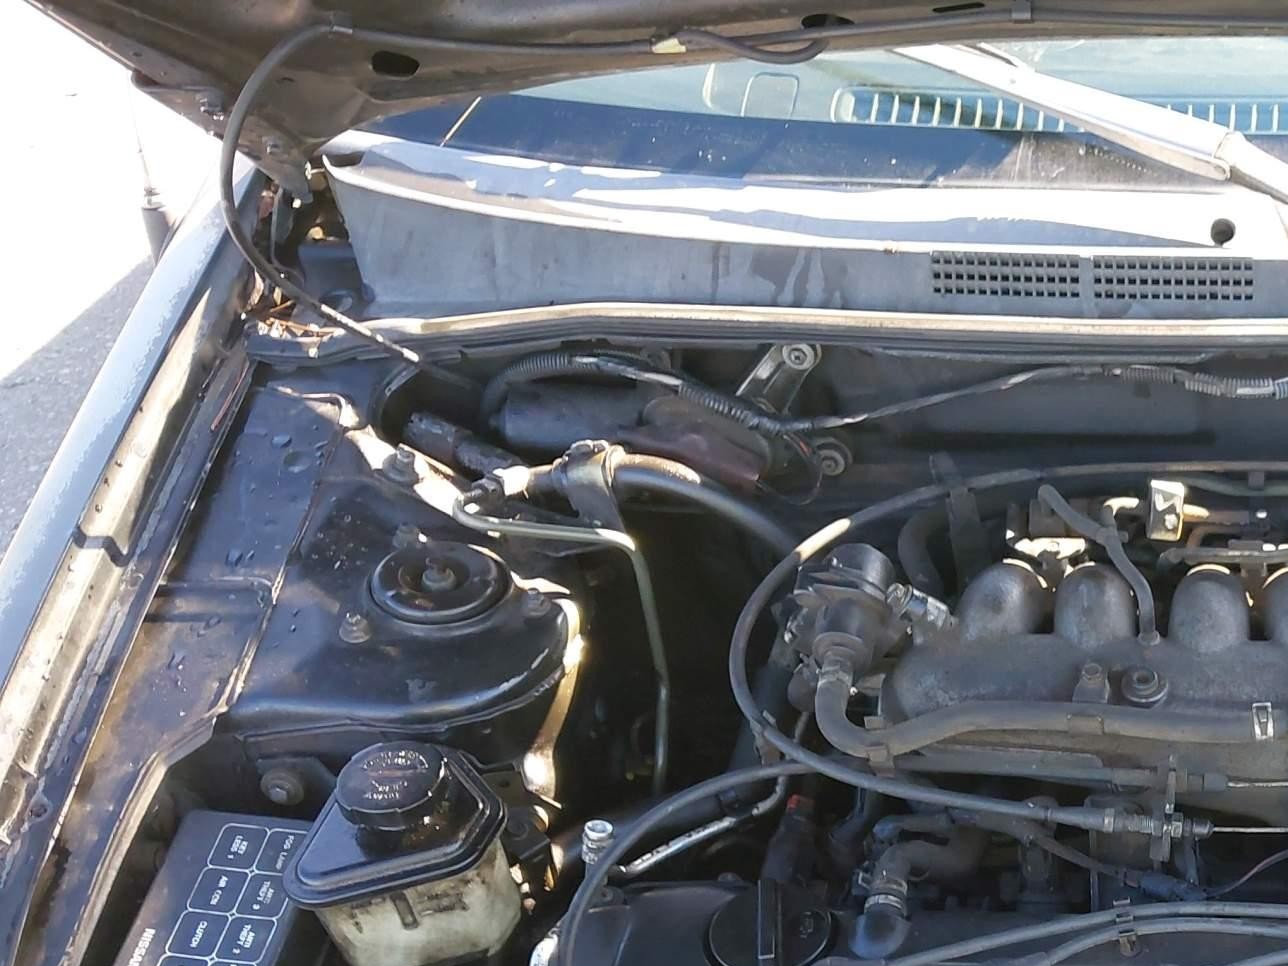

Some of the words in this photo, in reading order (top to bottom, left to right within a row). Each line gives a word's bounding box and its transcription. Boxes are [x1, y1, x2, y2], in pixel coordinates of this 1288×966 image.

[284, 835, 294, 850] FOG
[218, 875, 228, 888] AIR
[190, 920, 207, 948] CLUTCH
